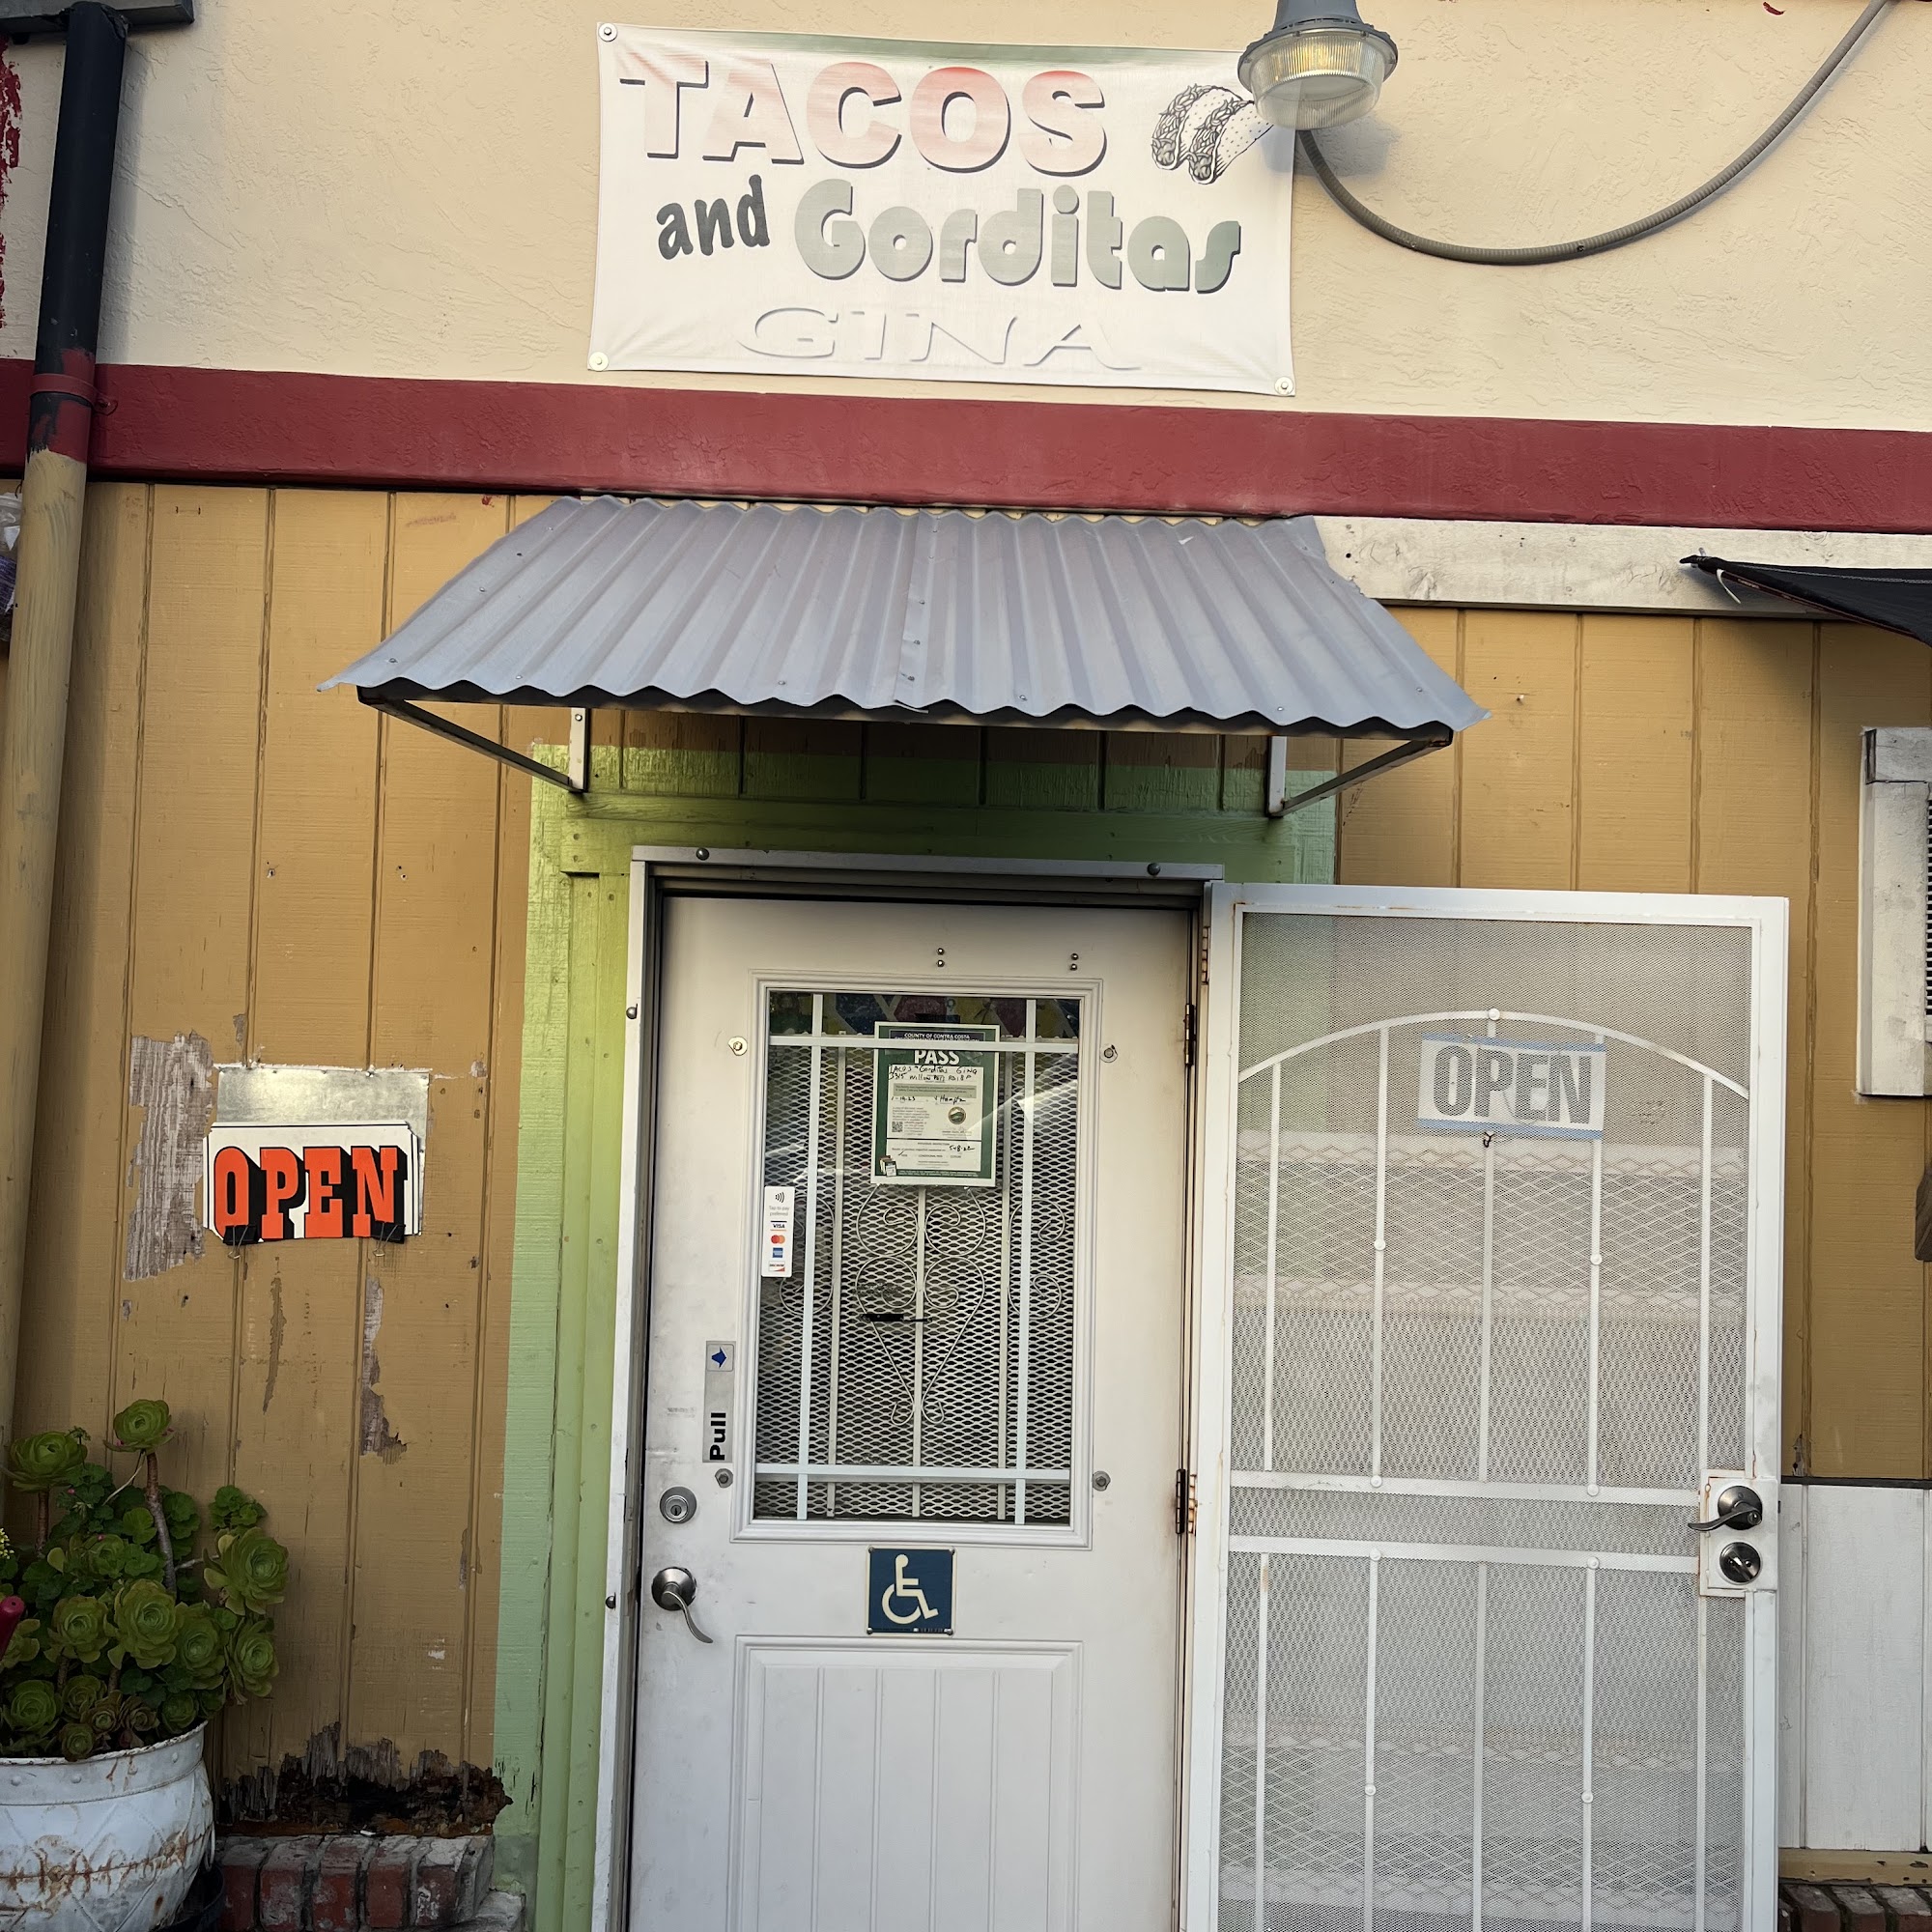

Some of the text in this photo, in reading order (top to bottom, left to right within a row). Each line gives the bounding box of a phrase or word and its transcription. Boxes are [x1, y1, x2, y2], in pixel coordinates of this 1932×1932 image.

[618, 56, 1108, 178] TACOS
[656, 174, 1241, 295] and Gorditas
[737, 306, 1142, 370] GINA
[914, 1050, 960, 1065] PASS
[1433, 1045, 1592, 1124] OPEN
[213, 1146, 408, 1239] OPEN
[710, 1412, 726, 1461] Pull
